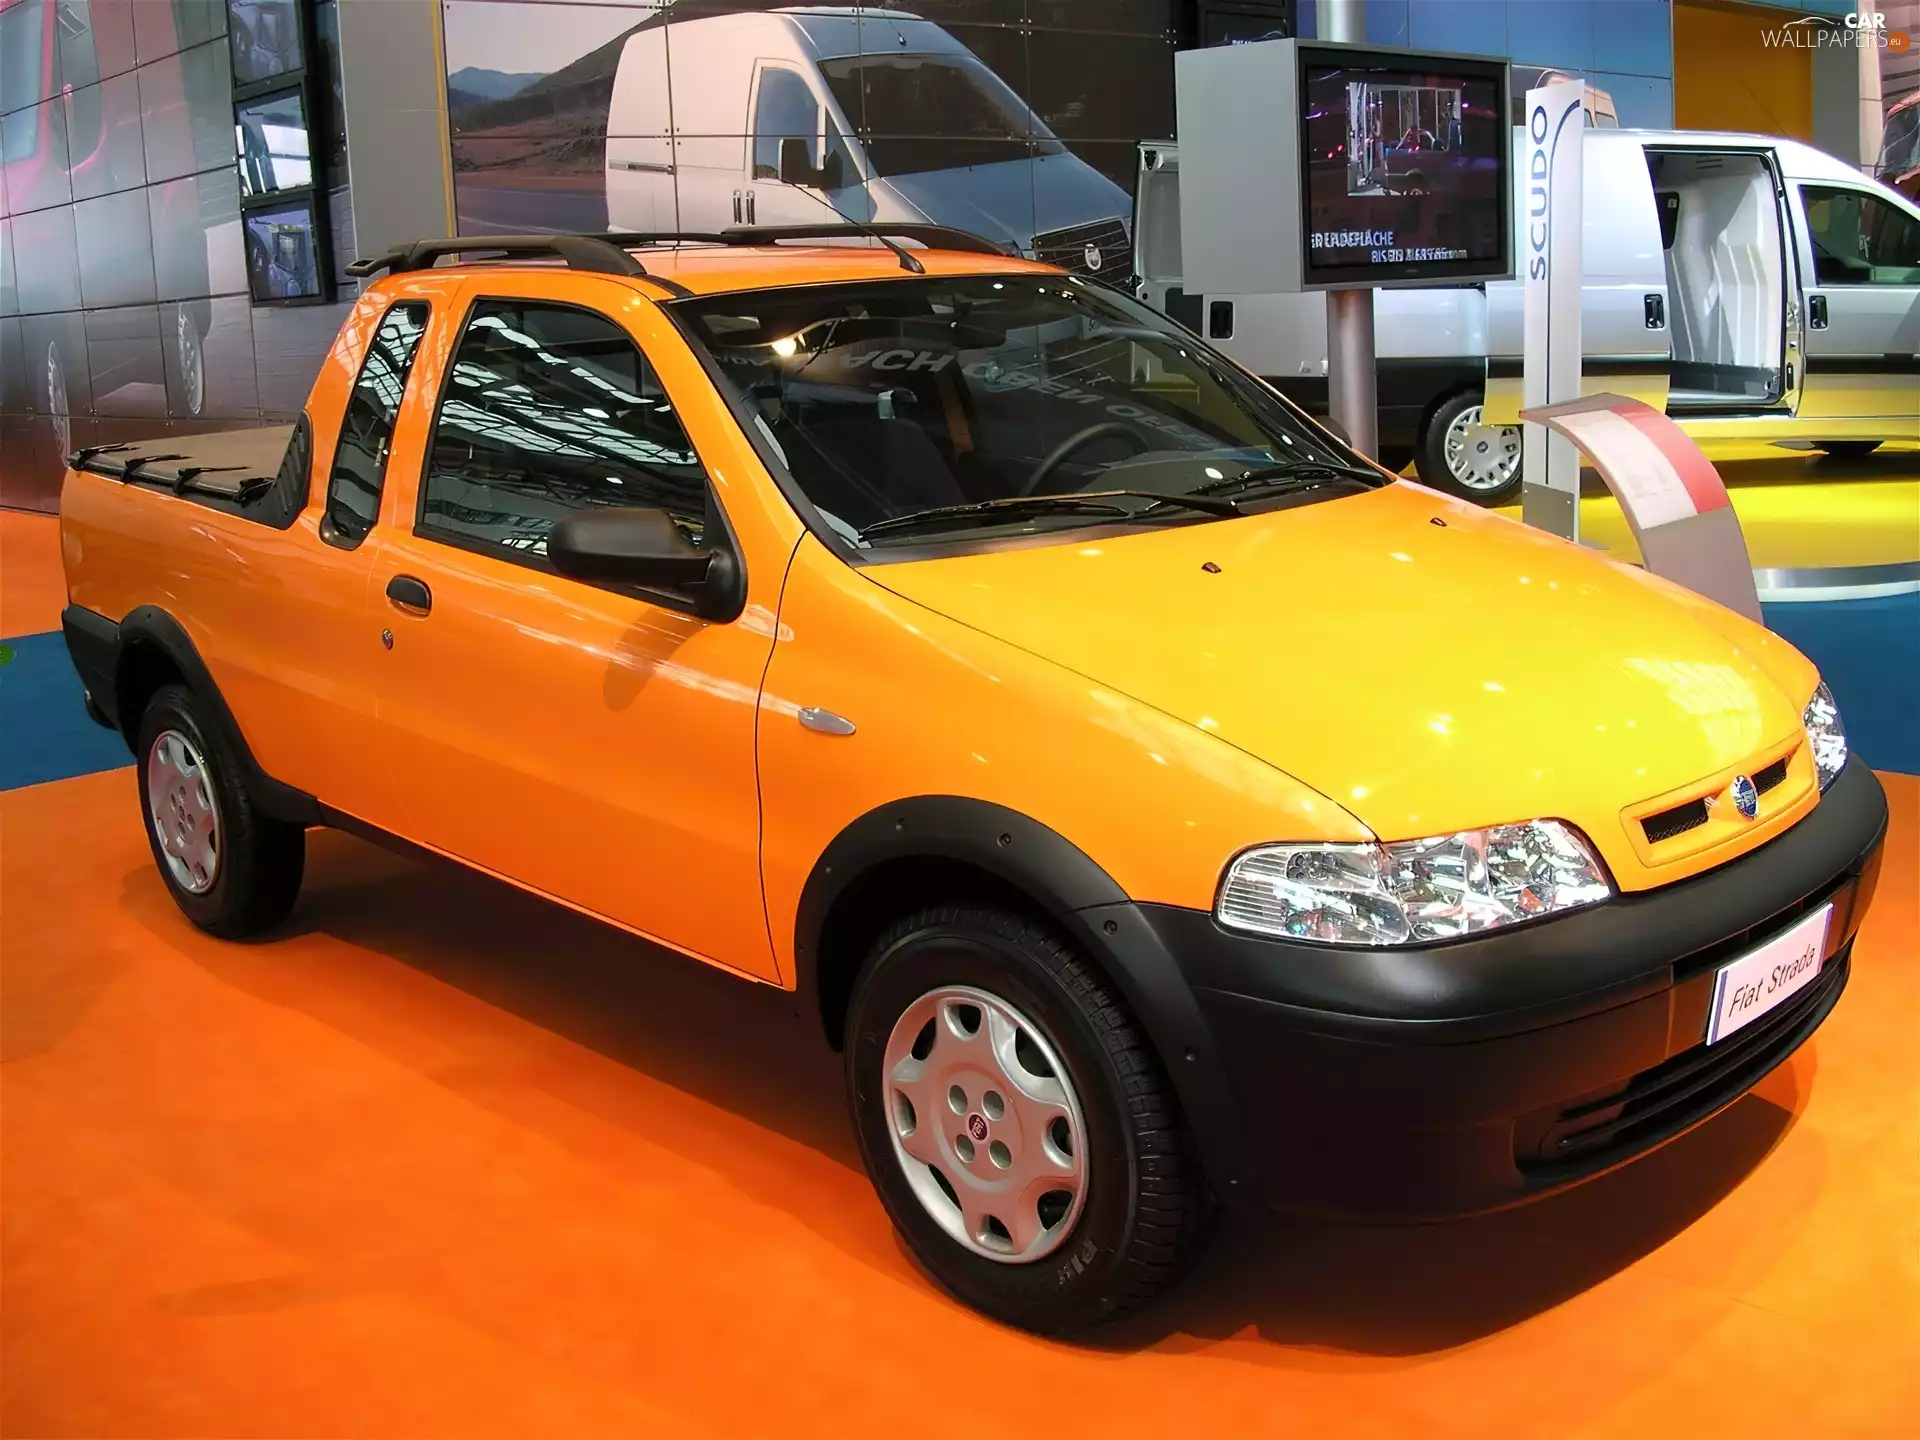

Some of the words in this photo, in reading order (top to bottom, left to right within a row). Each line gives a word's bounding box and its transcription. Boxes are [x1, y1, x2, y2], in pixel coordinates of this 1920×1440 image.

[1530, 105, 1548, 281] SCUDO
[1728, 977, 1764, 1018] Fiat
[1767, 943, 1816, 995] Strada
